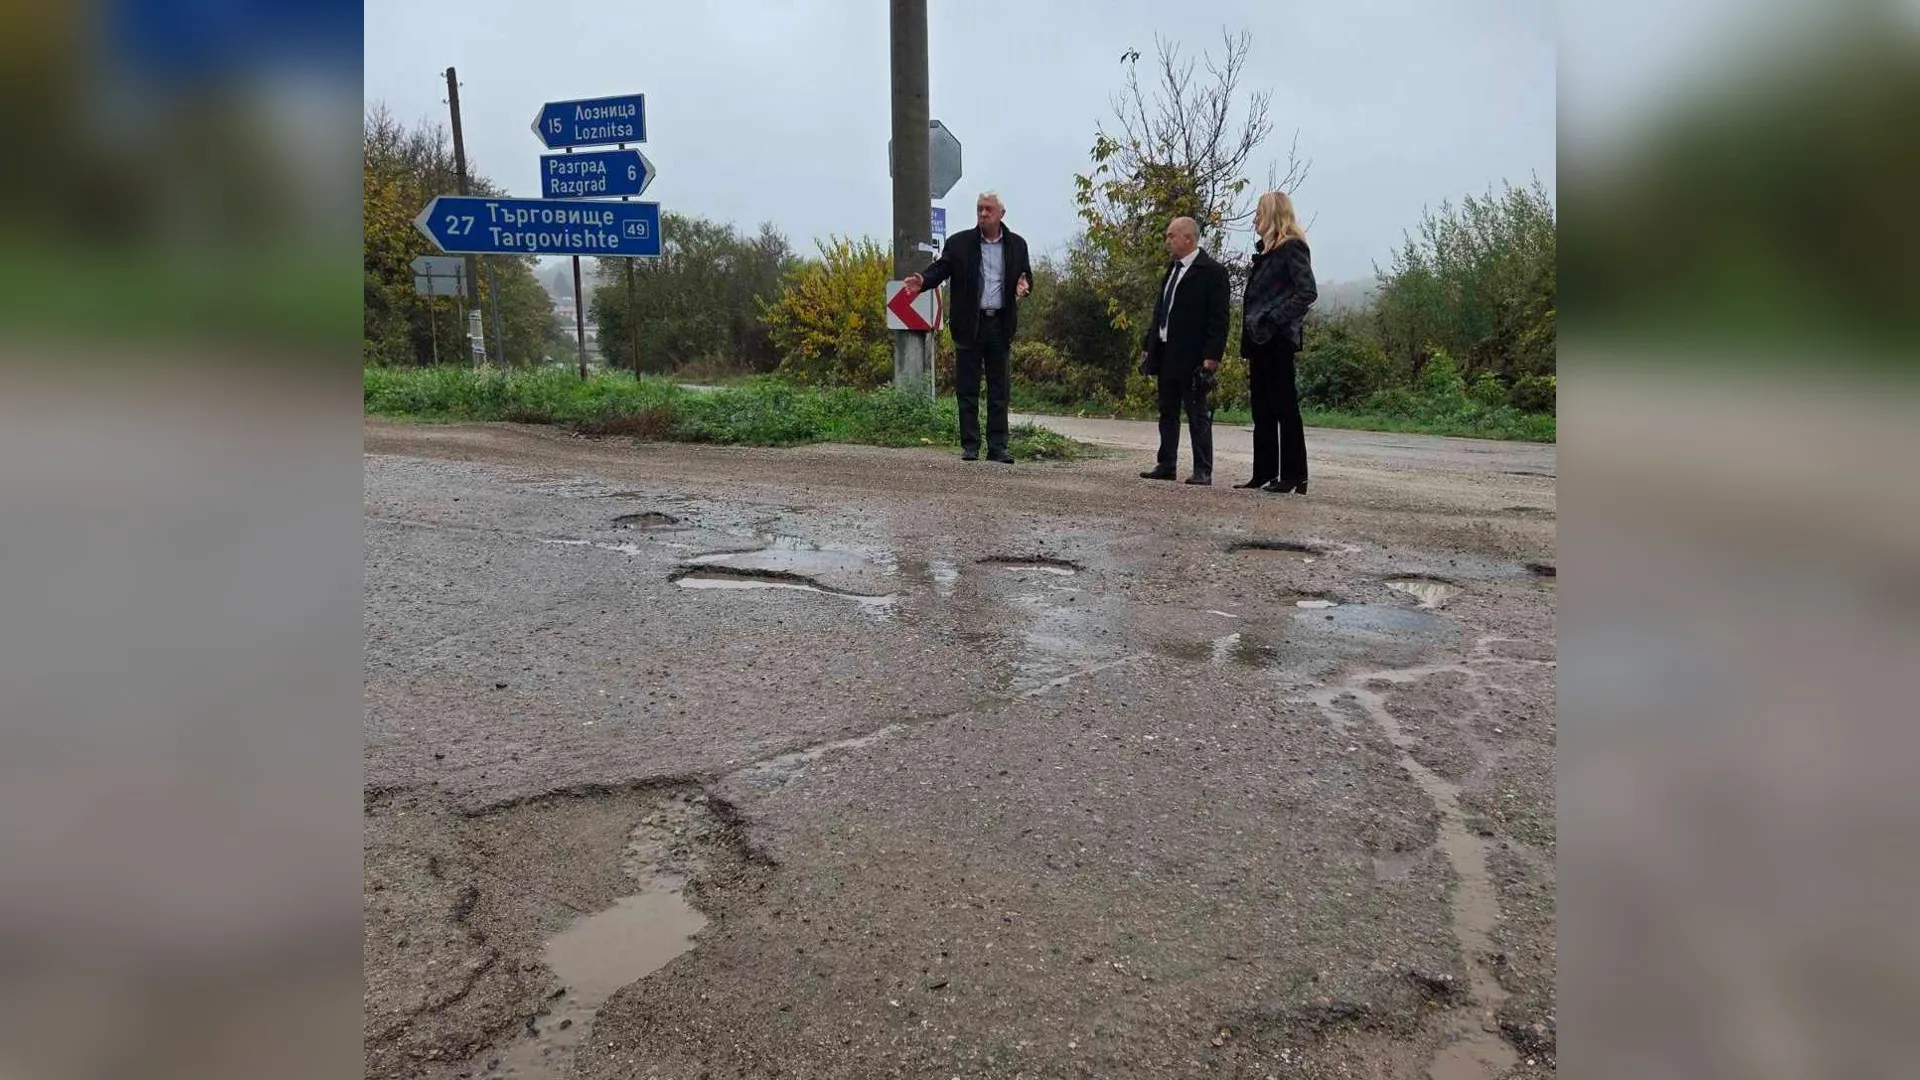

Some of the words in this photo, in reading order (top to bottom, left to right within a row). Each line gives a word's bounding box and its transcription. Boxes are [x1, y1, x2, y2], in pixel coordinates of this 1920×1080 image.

[575, 103, 635, 121] Лозница
[548, 118, 562, 134] 15
[575, 122, 633, 140] Loznitsa
[549, 160, 607, 175] Разград
[627, 165, 636, 181] 6
[551, 176, 606, 195] Razgrad
[486, 203, 614, 227] Търговище
[445, 215, 475, 236] 27
[627, 223, 645, 236] 49
[489, 227, 619, 251] Targovishte
